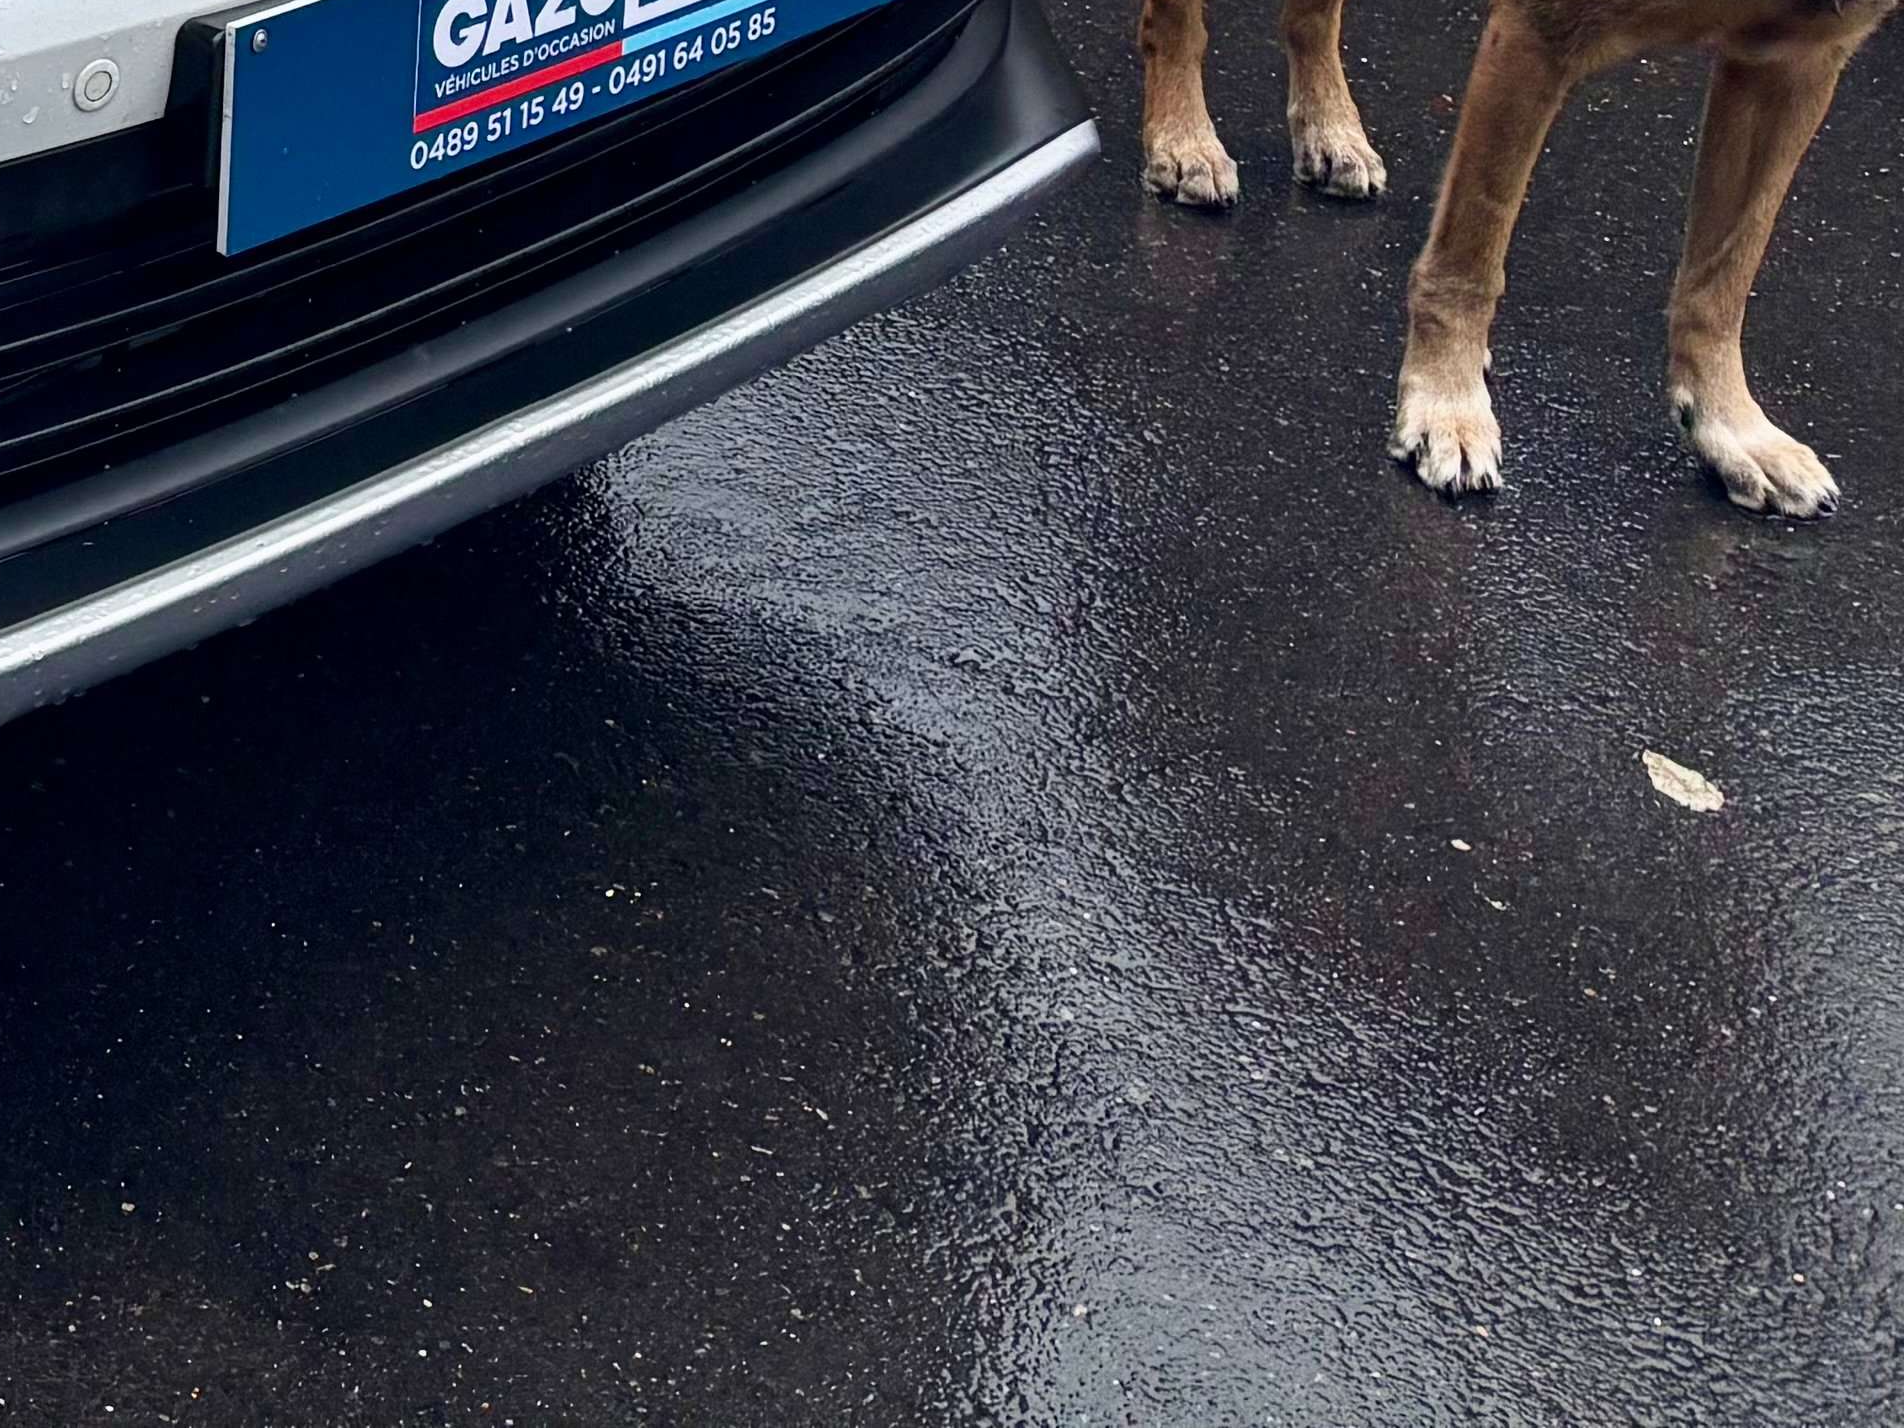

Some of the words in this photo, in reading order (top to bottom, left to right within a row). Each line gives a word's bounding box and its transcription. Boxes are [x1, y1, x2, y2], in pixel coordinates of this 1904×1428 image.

[410, 121, 479, 170] 0489
[487, 108, 511, 142] 51
[520, 96, 544, 129] 15
[552, 81, 584, 114] 49
[608, 49, 666, 95] 0491
[673, 35, 703, 70] 64
[710, 20, 741, 55] 05
[747, 7, 776, 41] 85
[435, 56, 520, 99] VÉHICULES
[522, 18, 616, 68] D'OCCASION
